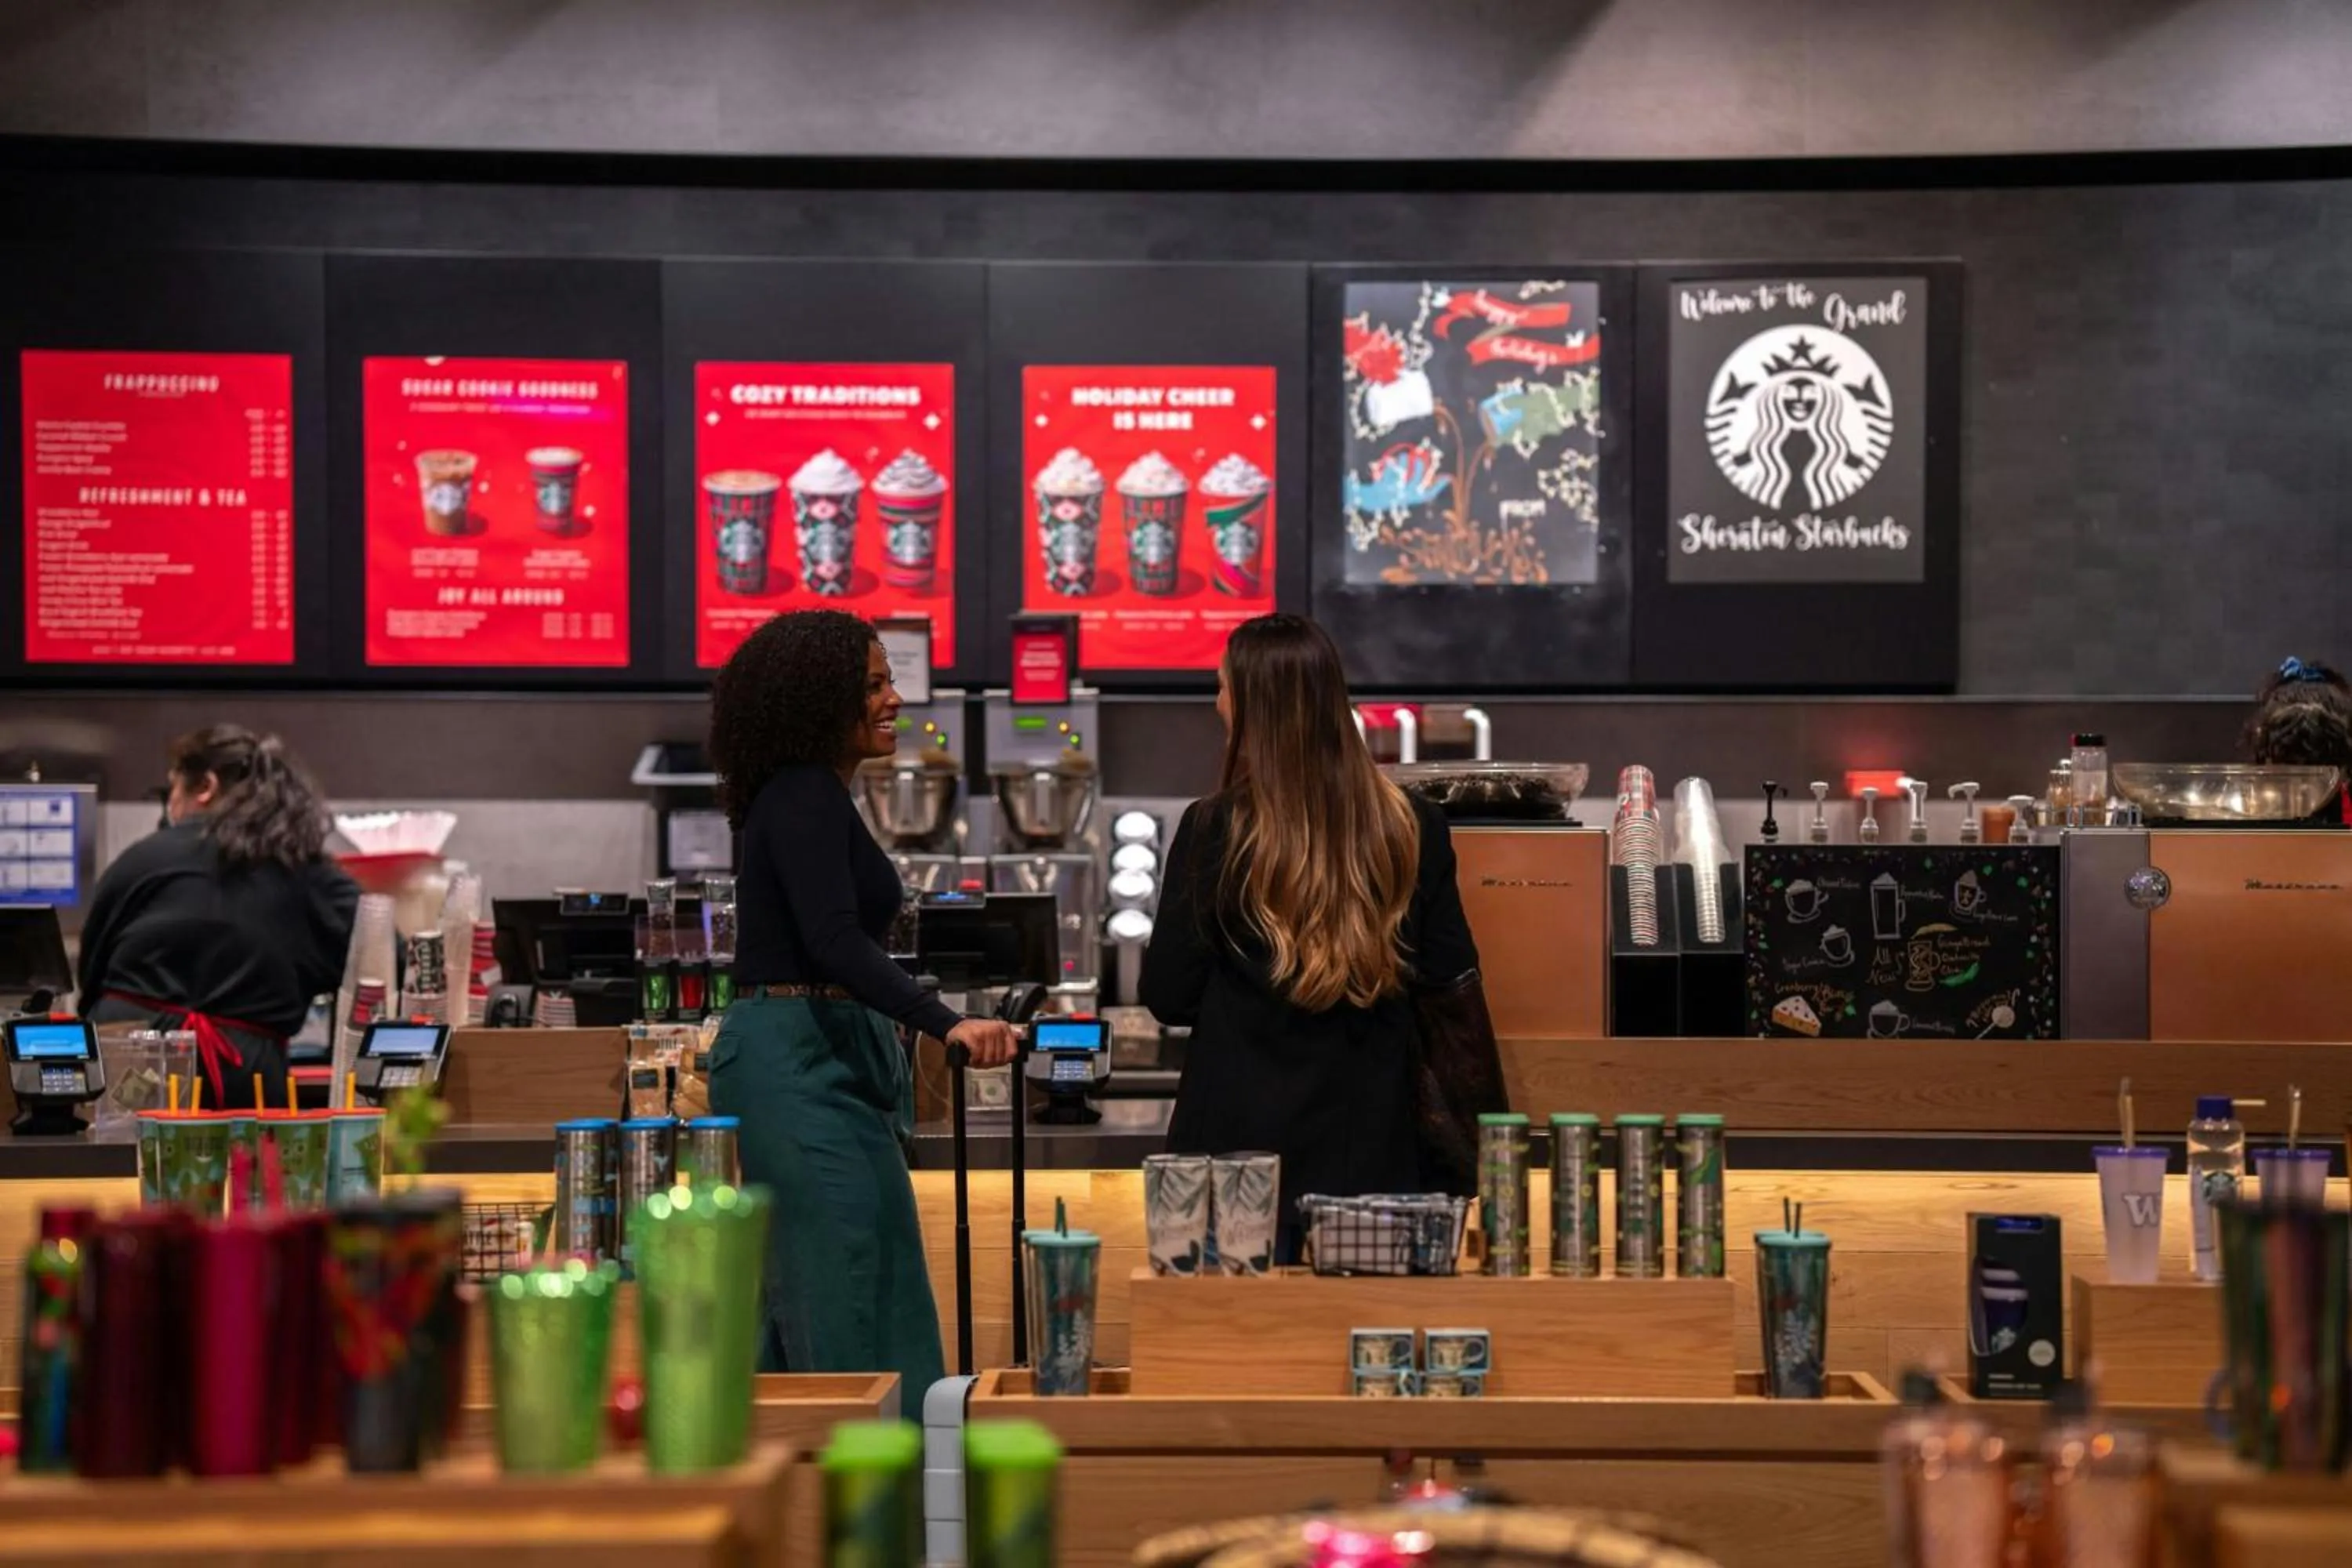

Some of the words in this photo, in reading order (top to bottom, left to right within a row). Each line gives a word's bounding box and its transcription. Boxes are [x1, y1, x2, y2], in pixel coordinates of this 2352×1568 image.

[1680, 288, 1753, 321] Welcome
[1751, 284, 1778, 310] to
[1777, 281, 1816, 308] the
[1824, 290, 1907, 333] Grand
[730, 383, 786, 404] COZY
[791, 385, 920, 405] TRADITIONS
[1071, 387, 1163, 405] HOLIDAY
[1167, 387, 1235, 405] CHEER
[1112, 412, 1135, 430] IS
[1138, 412, 1193, 430] HERE
[1677, 512, 1791, 554] Sheraton
[1791, 512, 1911, 551] Starbucks
[1872, 945, 1892, 965] All
[1864, 967, 1897, 985] New
[2122, 1191, 2158, 1228] W
